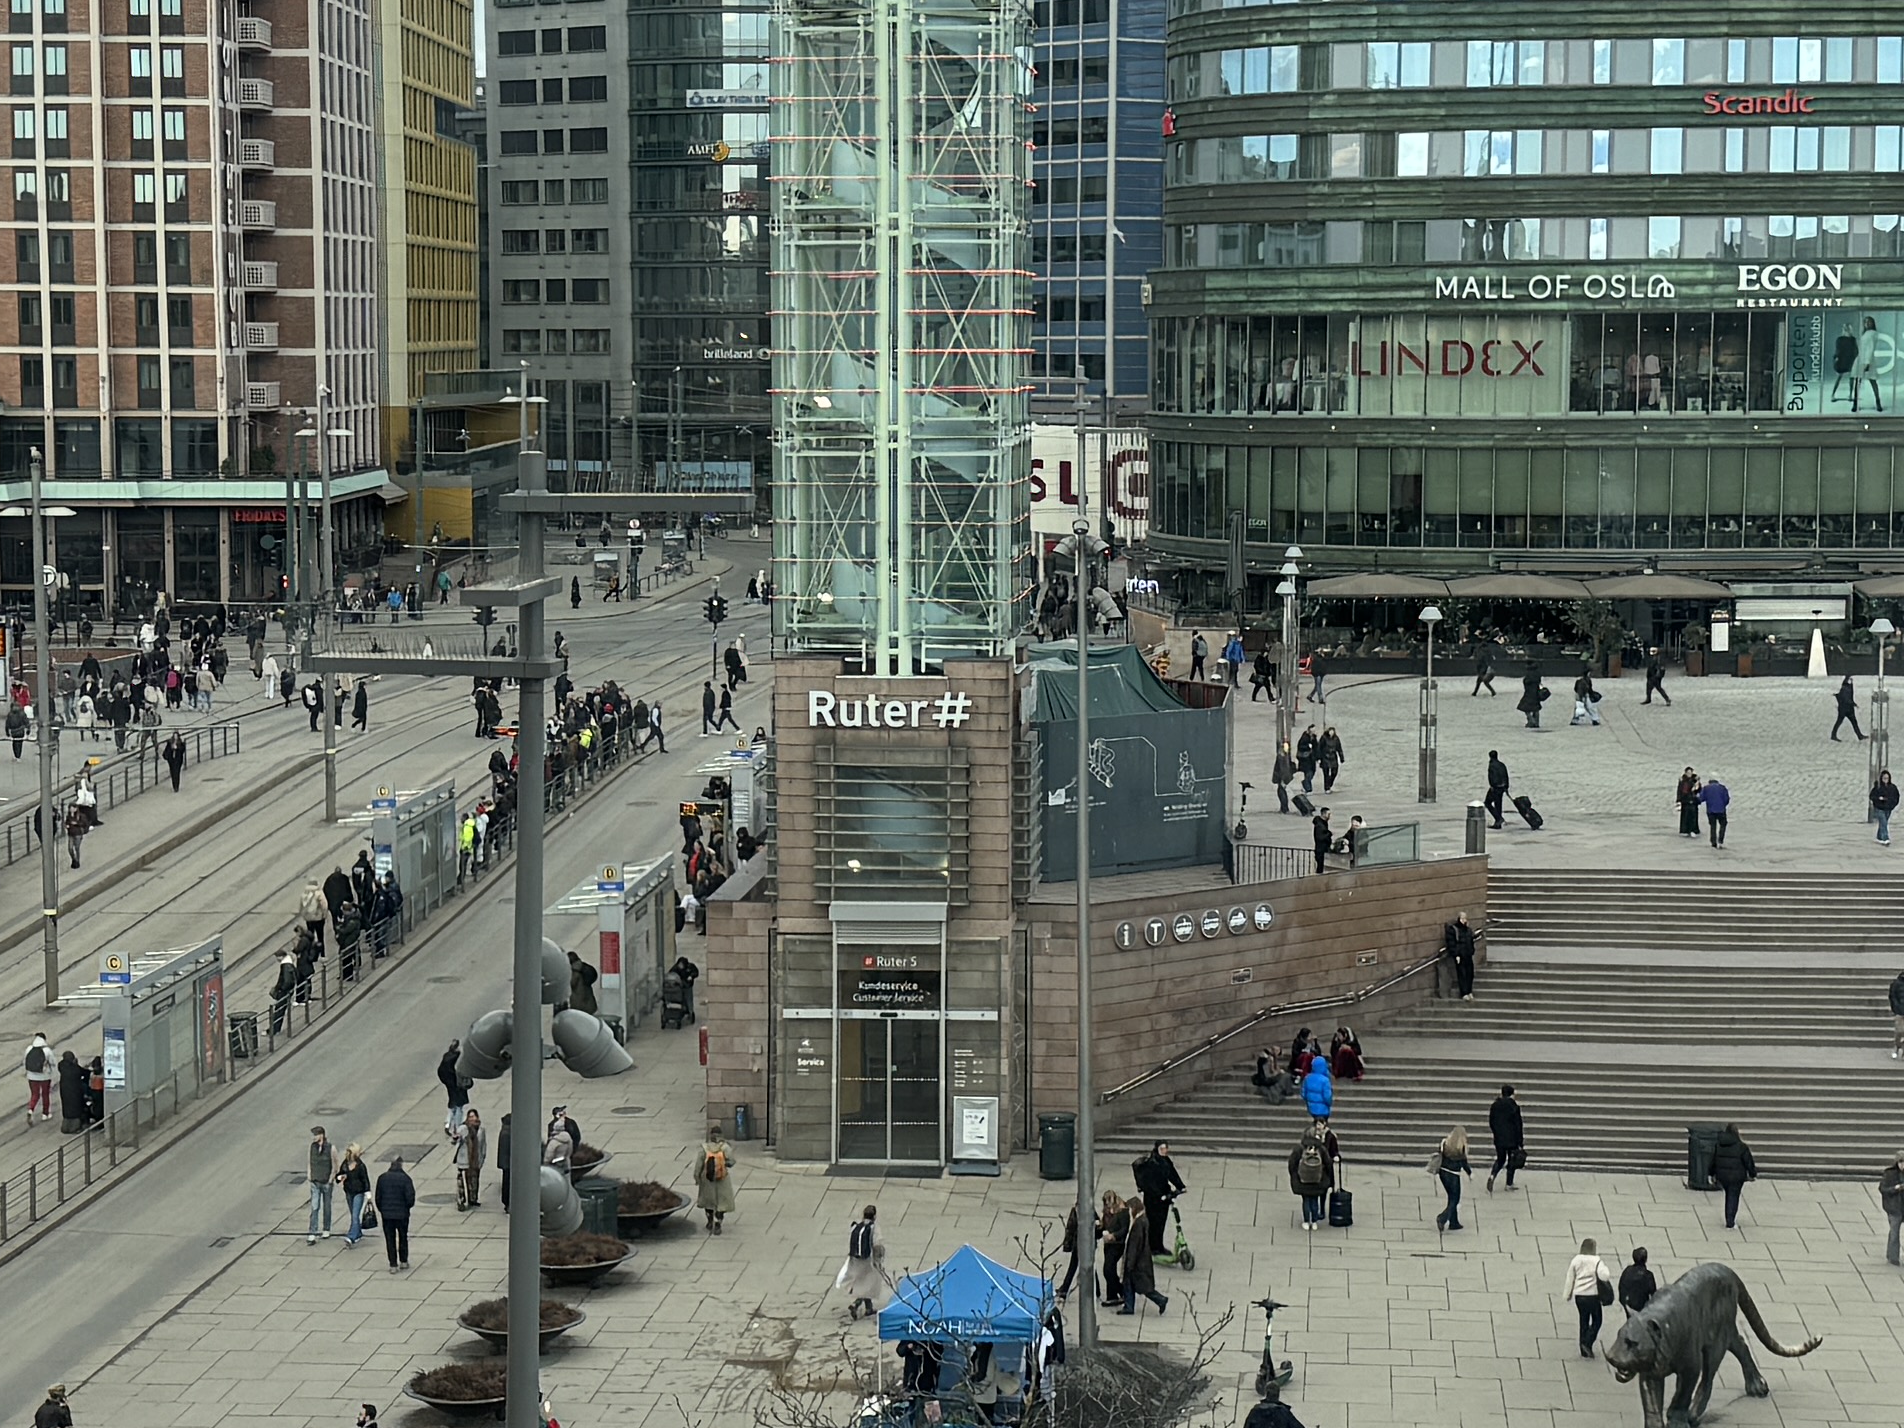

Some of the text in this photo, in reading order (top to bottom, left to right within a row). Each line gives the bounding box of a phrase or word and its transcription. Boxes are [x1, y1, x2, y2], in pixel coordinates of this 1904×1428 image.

[1704, 89, 1814, 114] Scandic
[1435, 275, 1515, 299] MALL
[1528, 274, 1571, 299] OF
[1737, 264, 1844, 292] EGON
[1736, 298, 1843, 308] RESTAURANT
[1351, 340, 1545, 377] LINDEX
[1809, 315, 1821, 383] kundeklubb
[876, 956, 907, 967] Ruter
[910, 956, 917, 967] S
[858, 981, 919, 990] Kundeservice
[908, 1320, 962, 1334] NOAH
